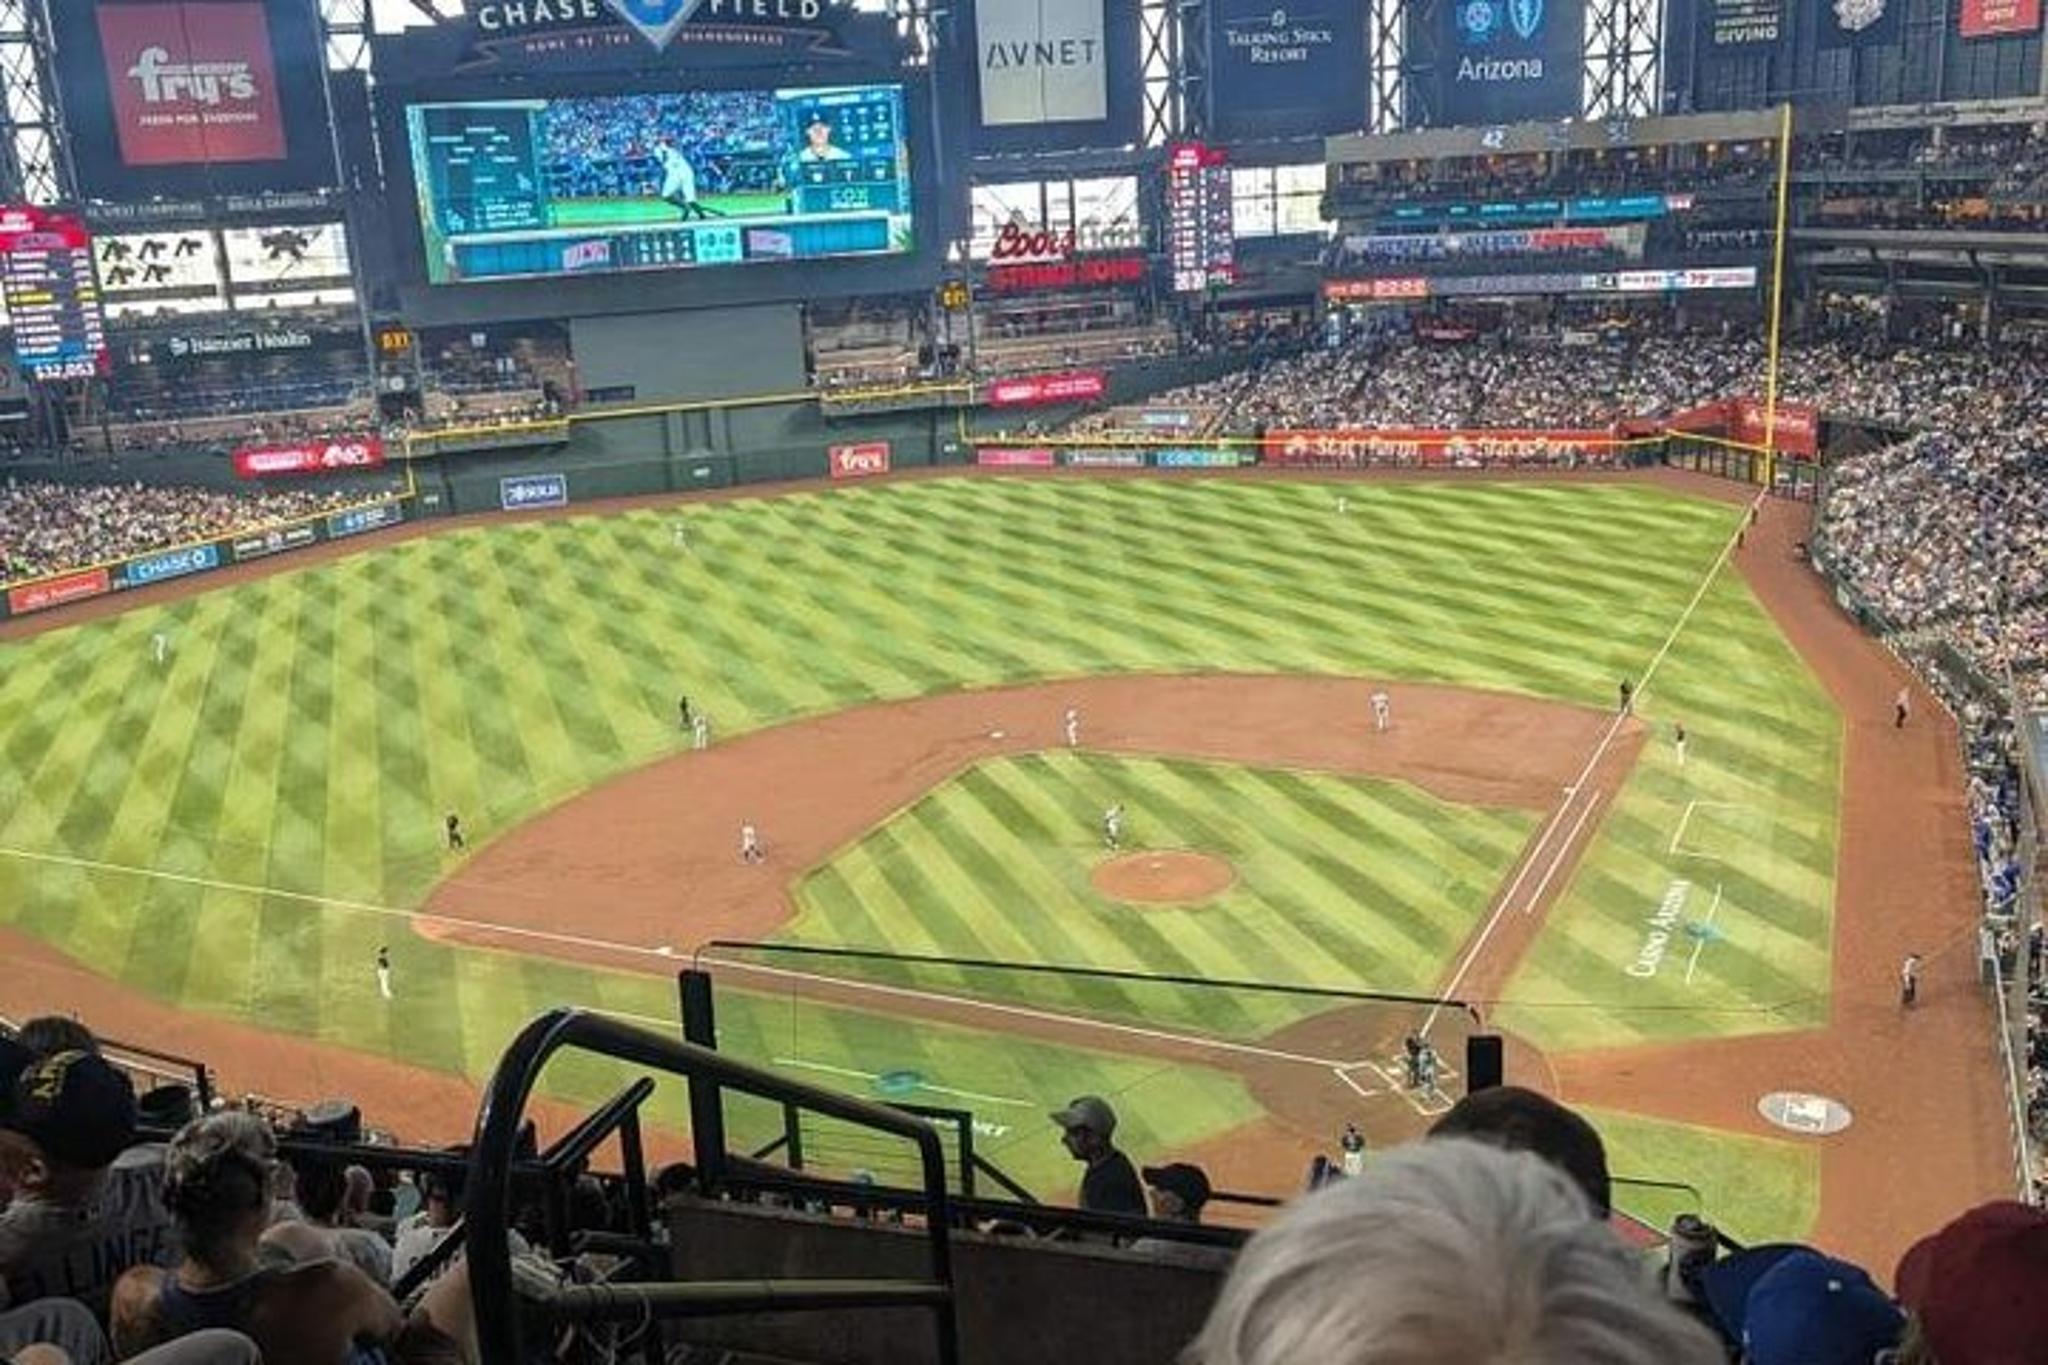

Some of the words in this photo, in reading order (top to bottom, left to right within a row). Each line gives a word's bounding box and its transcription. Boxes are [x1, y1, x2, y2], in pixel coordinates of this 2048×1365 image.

[479, 0, 598, 29] CHASE
[709, 0, 820, 18] FIELD
[1228, 29, 1289, 46] TALKING
[1293, 28, 1332, 44] STICK
[1715, 26, 1778, 44] GIVING
[986, 38, 1097, 68] AVNET
[1250, 48, 1308, 64] RESORT
[128, 46, 258, 103] fry's
[1457, 56, 1544, 82] Arizona
[993, 221, 1075, 259] Coors
[138, 555, 190, 580] CHASE
